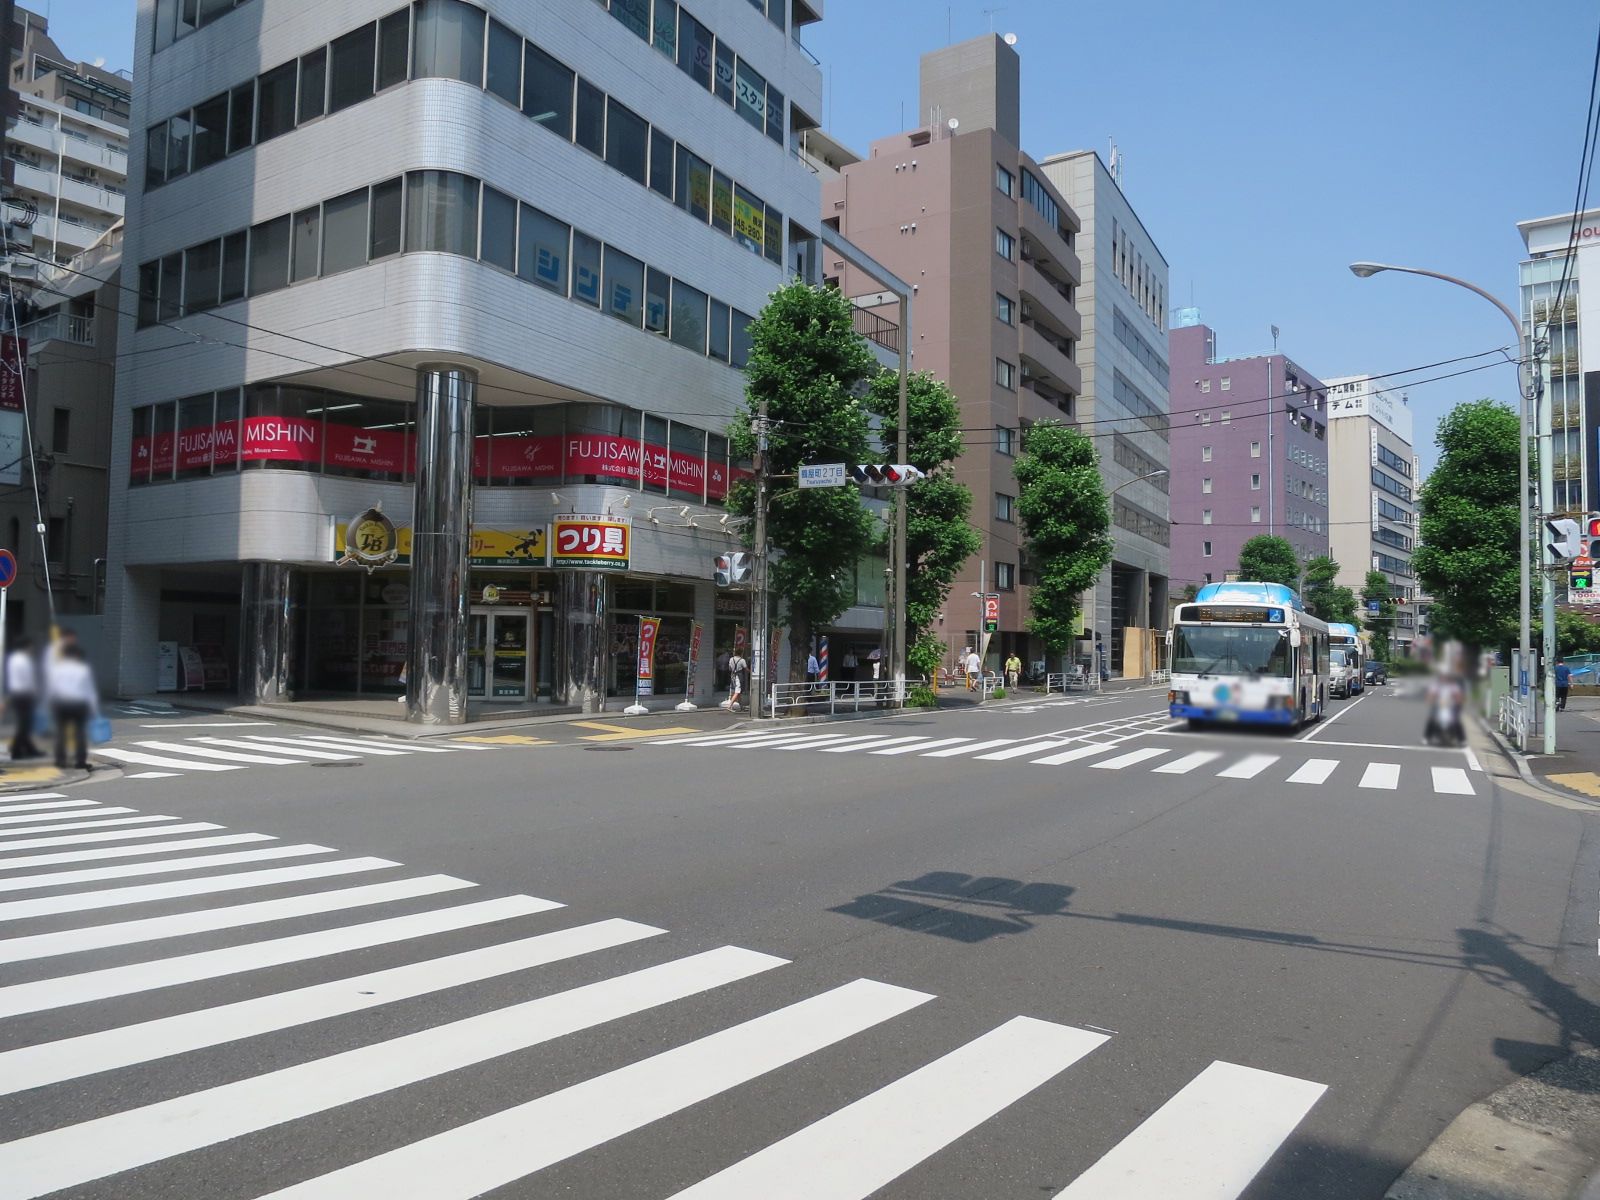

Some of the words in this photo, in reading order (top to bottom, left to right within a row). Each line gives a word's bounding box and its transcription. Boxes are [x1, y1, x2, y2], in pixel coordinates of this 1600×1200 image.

[179, 429, 235, 453] FUJISAWA
[246, 422, 315, 444] MISHIN
[569, 440, 653, 467] FUJISAWA
[668, 458, 704, 479] MISHIN
[559, 527, 624, 554] つり具
[640, 624, 655, 674] つり具
